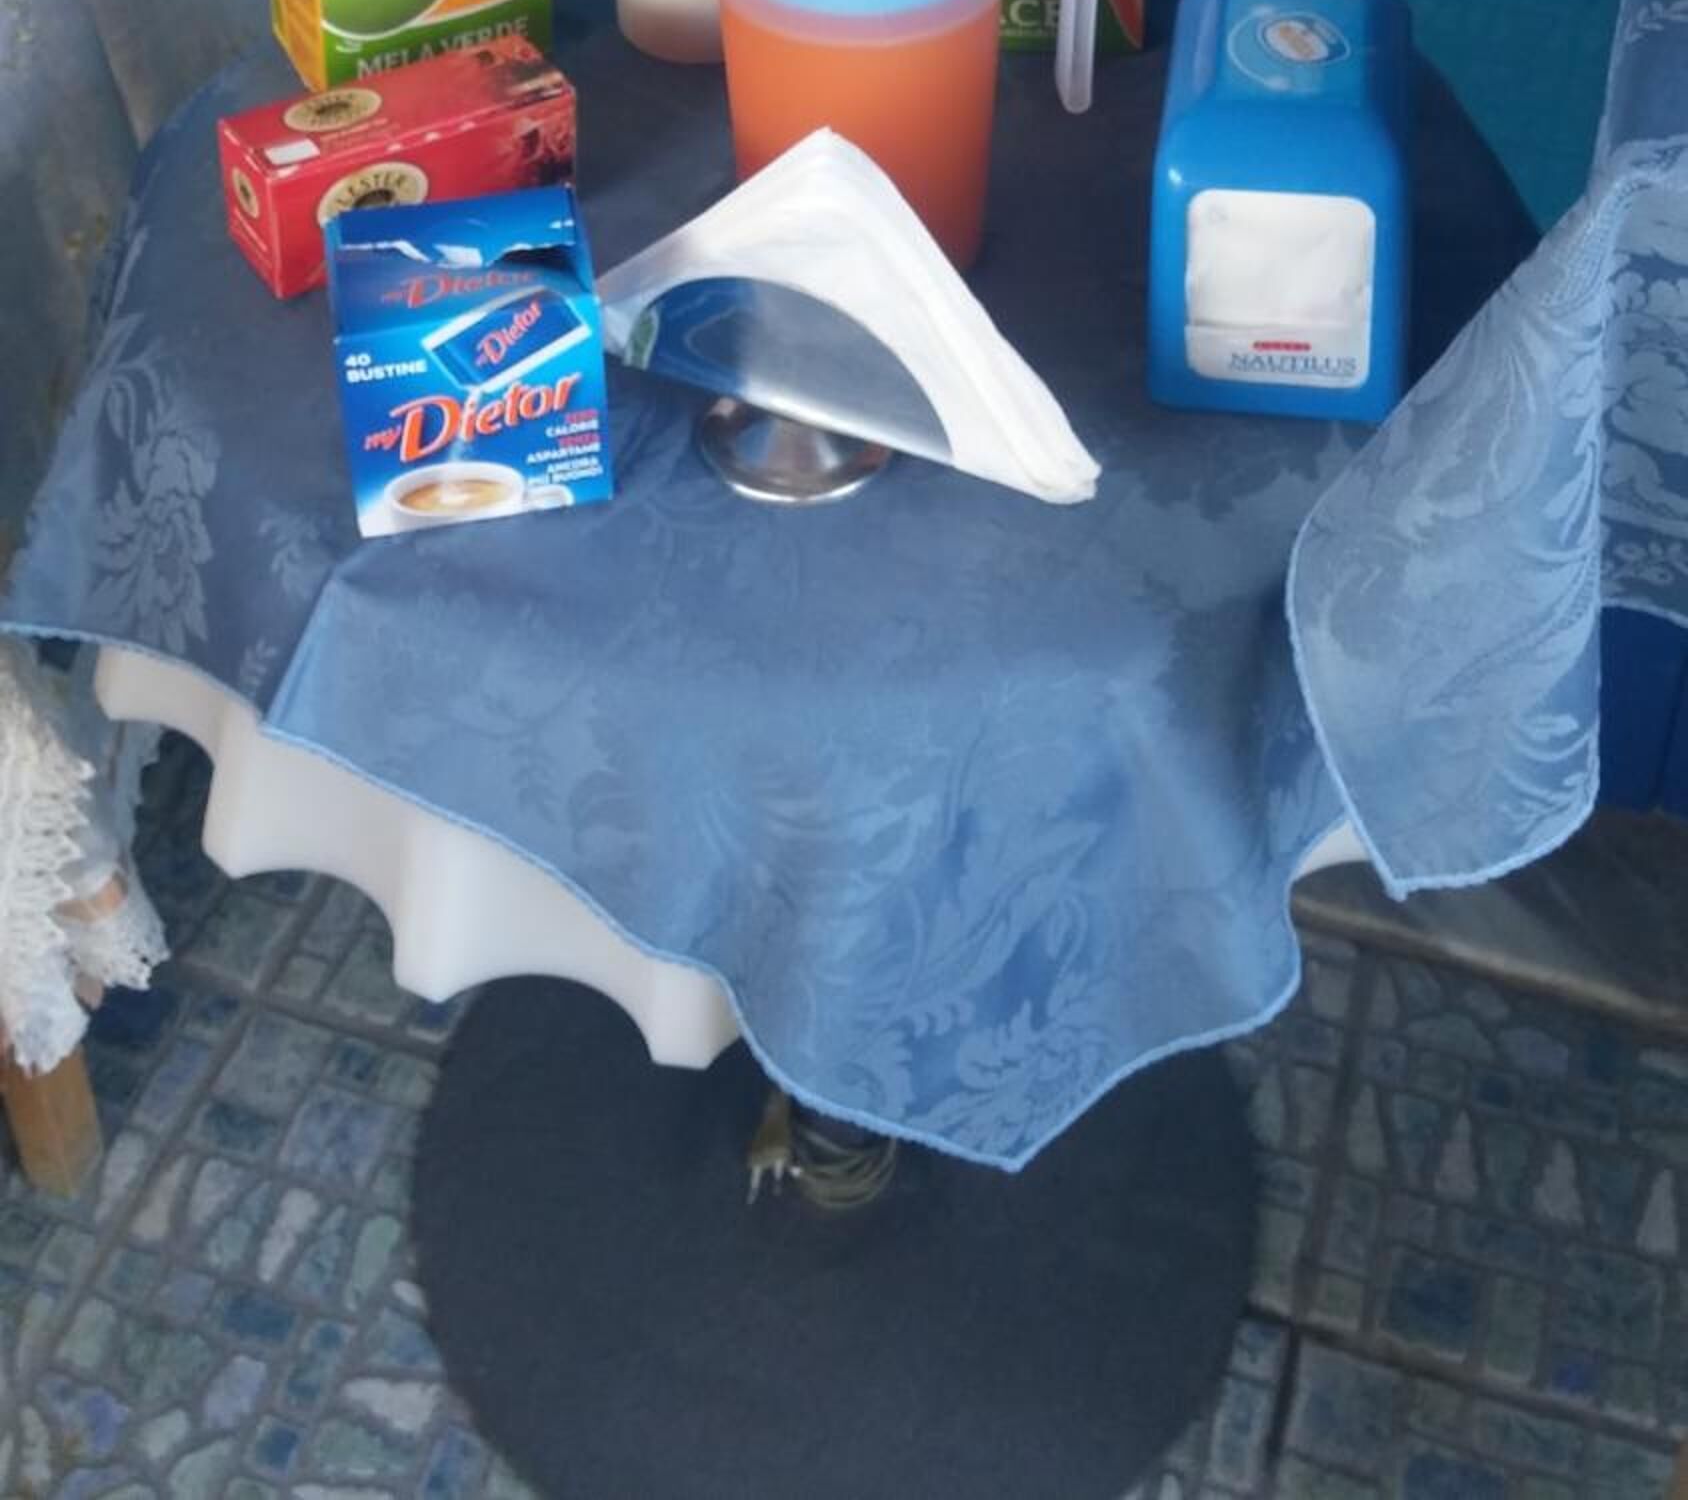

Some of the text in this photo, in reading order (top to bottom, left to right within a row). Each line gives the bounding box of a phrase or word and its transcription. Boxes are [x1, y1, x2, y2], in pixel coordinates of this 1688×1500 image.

[478, 301, 542, 364] Dietor
[345, 353, 372, 368] 40
[346, 359, 428, 383] BUSTINE
[1229, 353, 1358, 378] NAUTILUS
[364, 373, 583, 464] my Dietor
[545, 419, 599, 438] CALORIE
